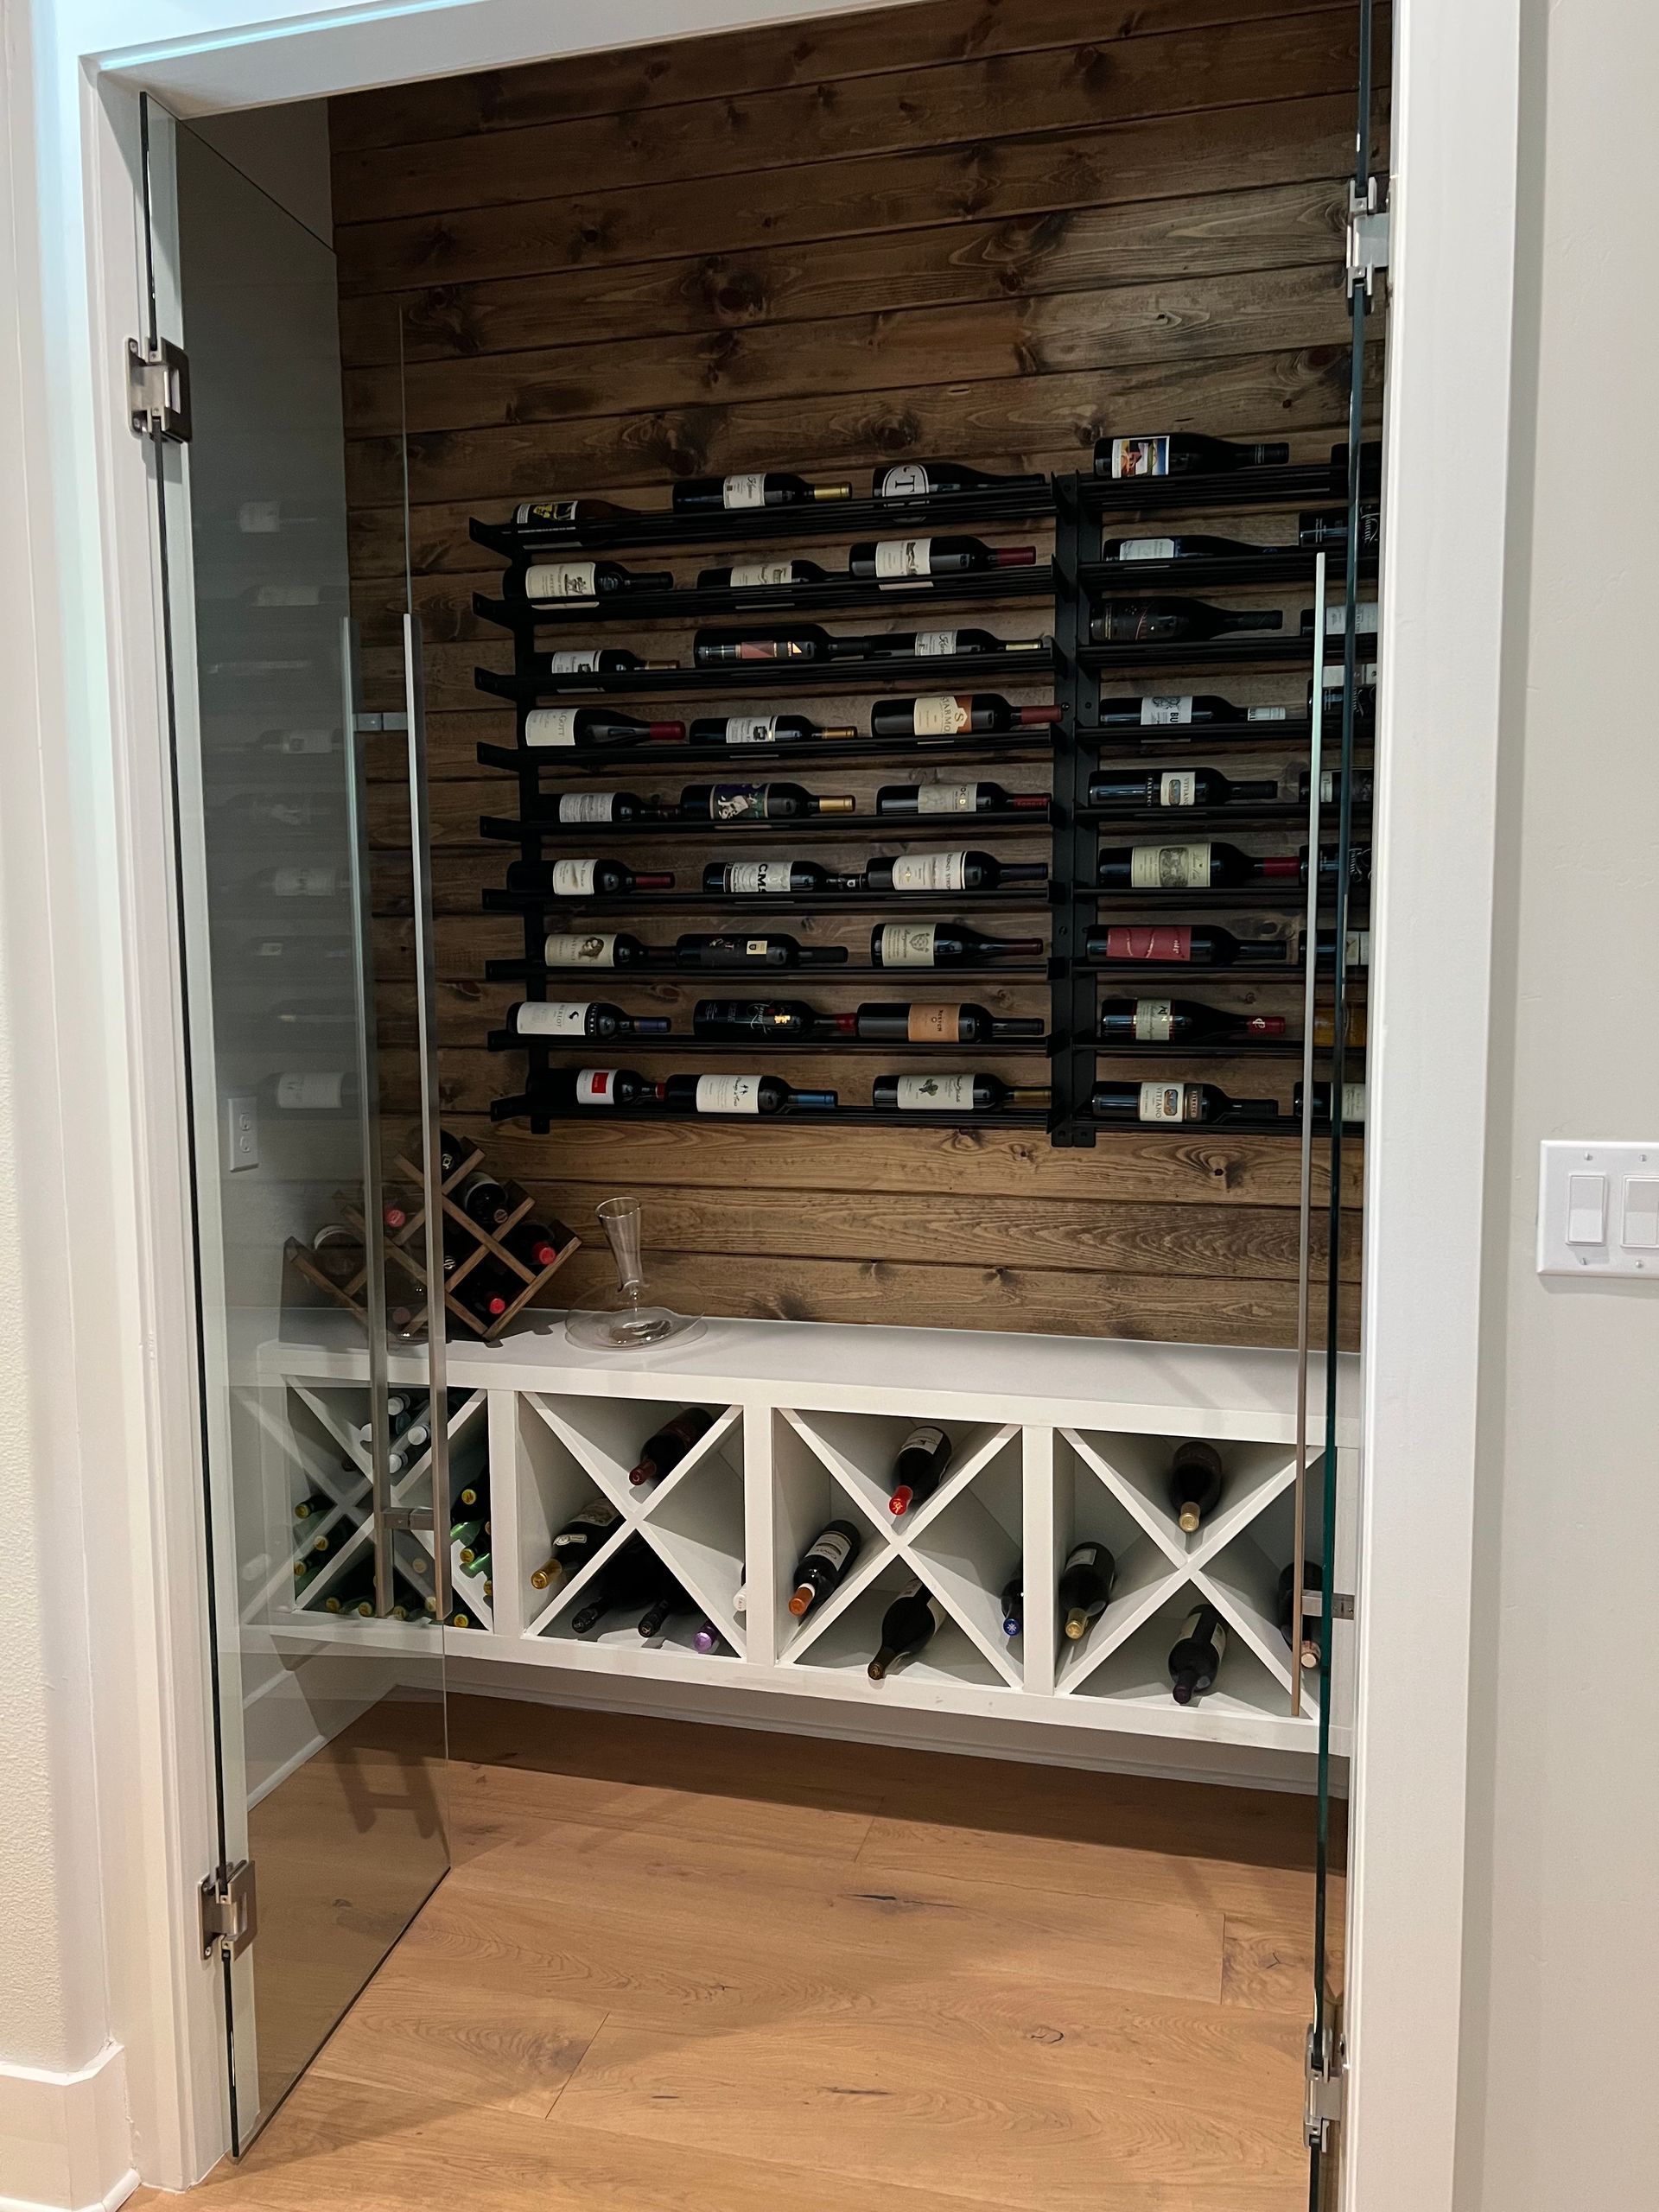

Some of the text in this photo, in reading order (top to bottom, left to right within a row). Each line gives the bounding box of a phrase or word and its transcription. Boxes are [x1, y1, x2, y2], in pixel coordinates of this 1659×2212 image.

[942, 696, 952, 734] STARMO
[954, 712, 964, 722] S
[1154, 1087, 1164, 1119] VITIANO
